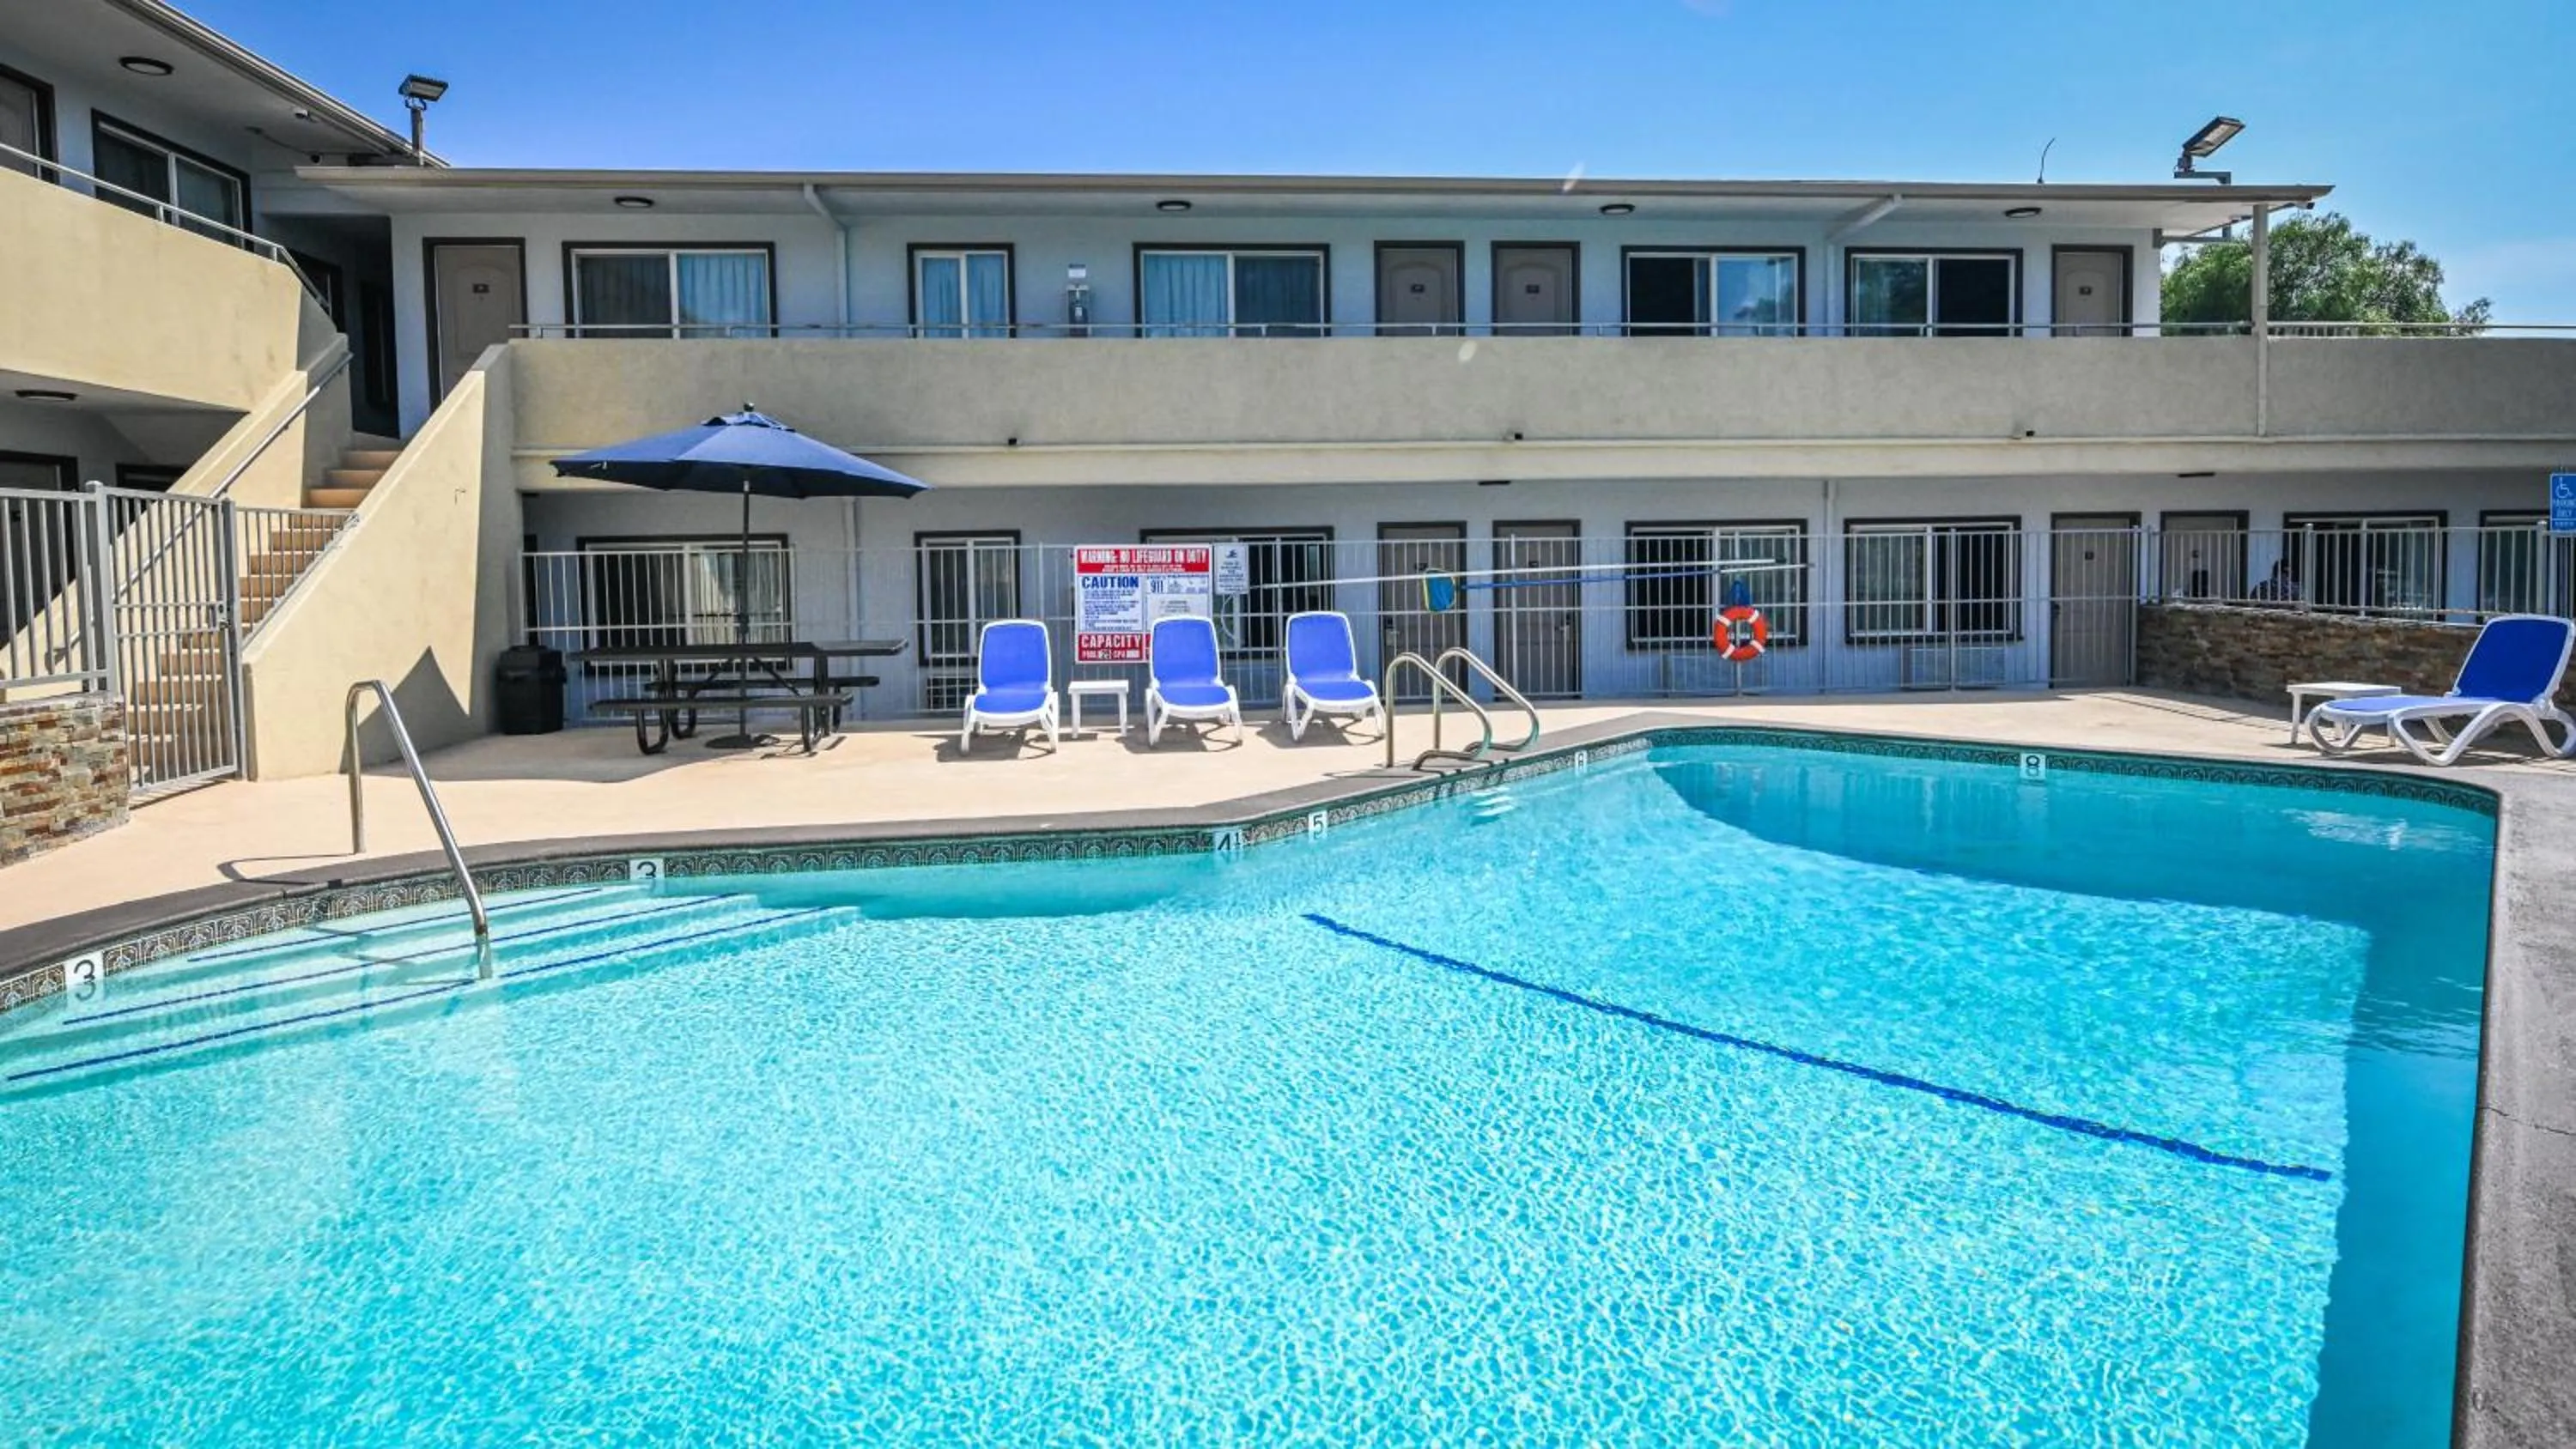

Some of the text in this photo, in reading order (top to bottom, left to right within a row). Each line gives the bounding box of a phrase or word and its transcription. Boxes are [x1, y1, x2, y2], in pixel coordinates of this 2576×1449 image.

[1120, 549, 1130, 563] NO
[1131, 549, 1171, 563] LIFEGUARD
[1174, 549, 1184, 563] ON
[1186, 549, 1206, 563] DUTY
[1081, 576, 1139, 588] CAUTION
[1150, 579, 1163, 593] 911
[1081, 634, 1140, 648] CAPACITY
[2026, 755, 2040, 776] 8
[1314, 814, 1324, 836] 5
[73, 959, 96, 1002] 3
